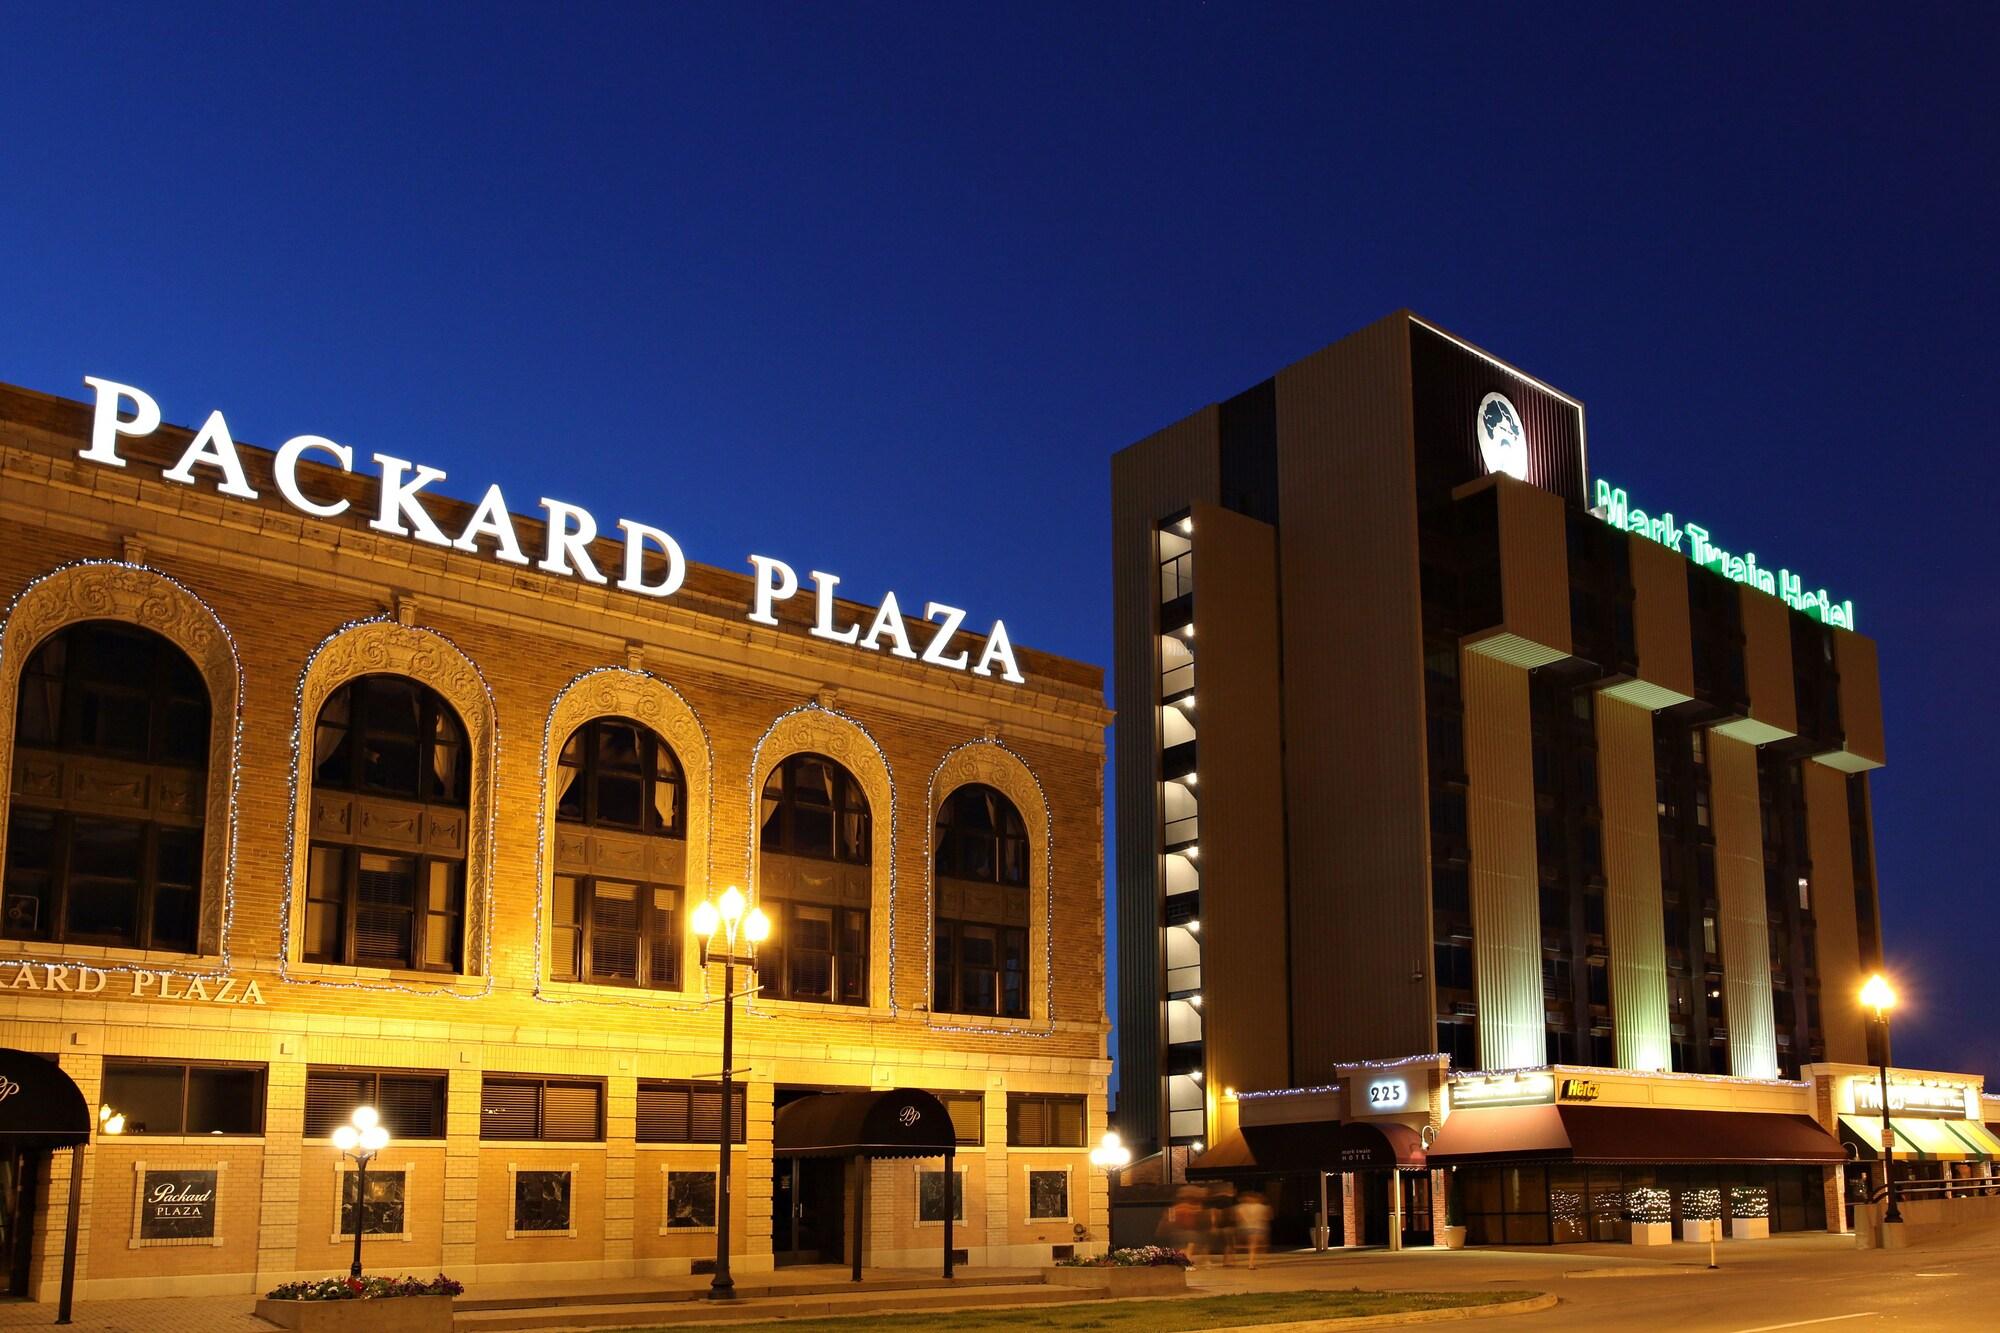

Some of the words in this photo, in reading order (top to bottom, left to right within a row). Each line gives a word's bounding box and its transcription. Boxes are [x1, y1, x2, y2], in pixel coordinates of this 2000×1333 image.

[78, 375, 687, 598] PACKARD
[746, 554, 1025, 684] PLAZA
[1594, 478, 1683, 552] Mark
[1685, 522, 1775, 596] Twain
[0, 964, 107, 993] ARD
[130, 970, 267, 1005] PLAZA
[1371, 1085, 1401, 1103] 225
[1566, 1079, 1601, 1097] Hertz
[148, 1183, 212, 1203] Packard
[157, 1207, 201, 1216] PLAZA
